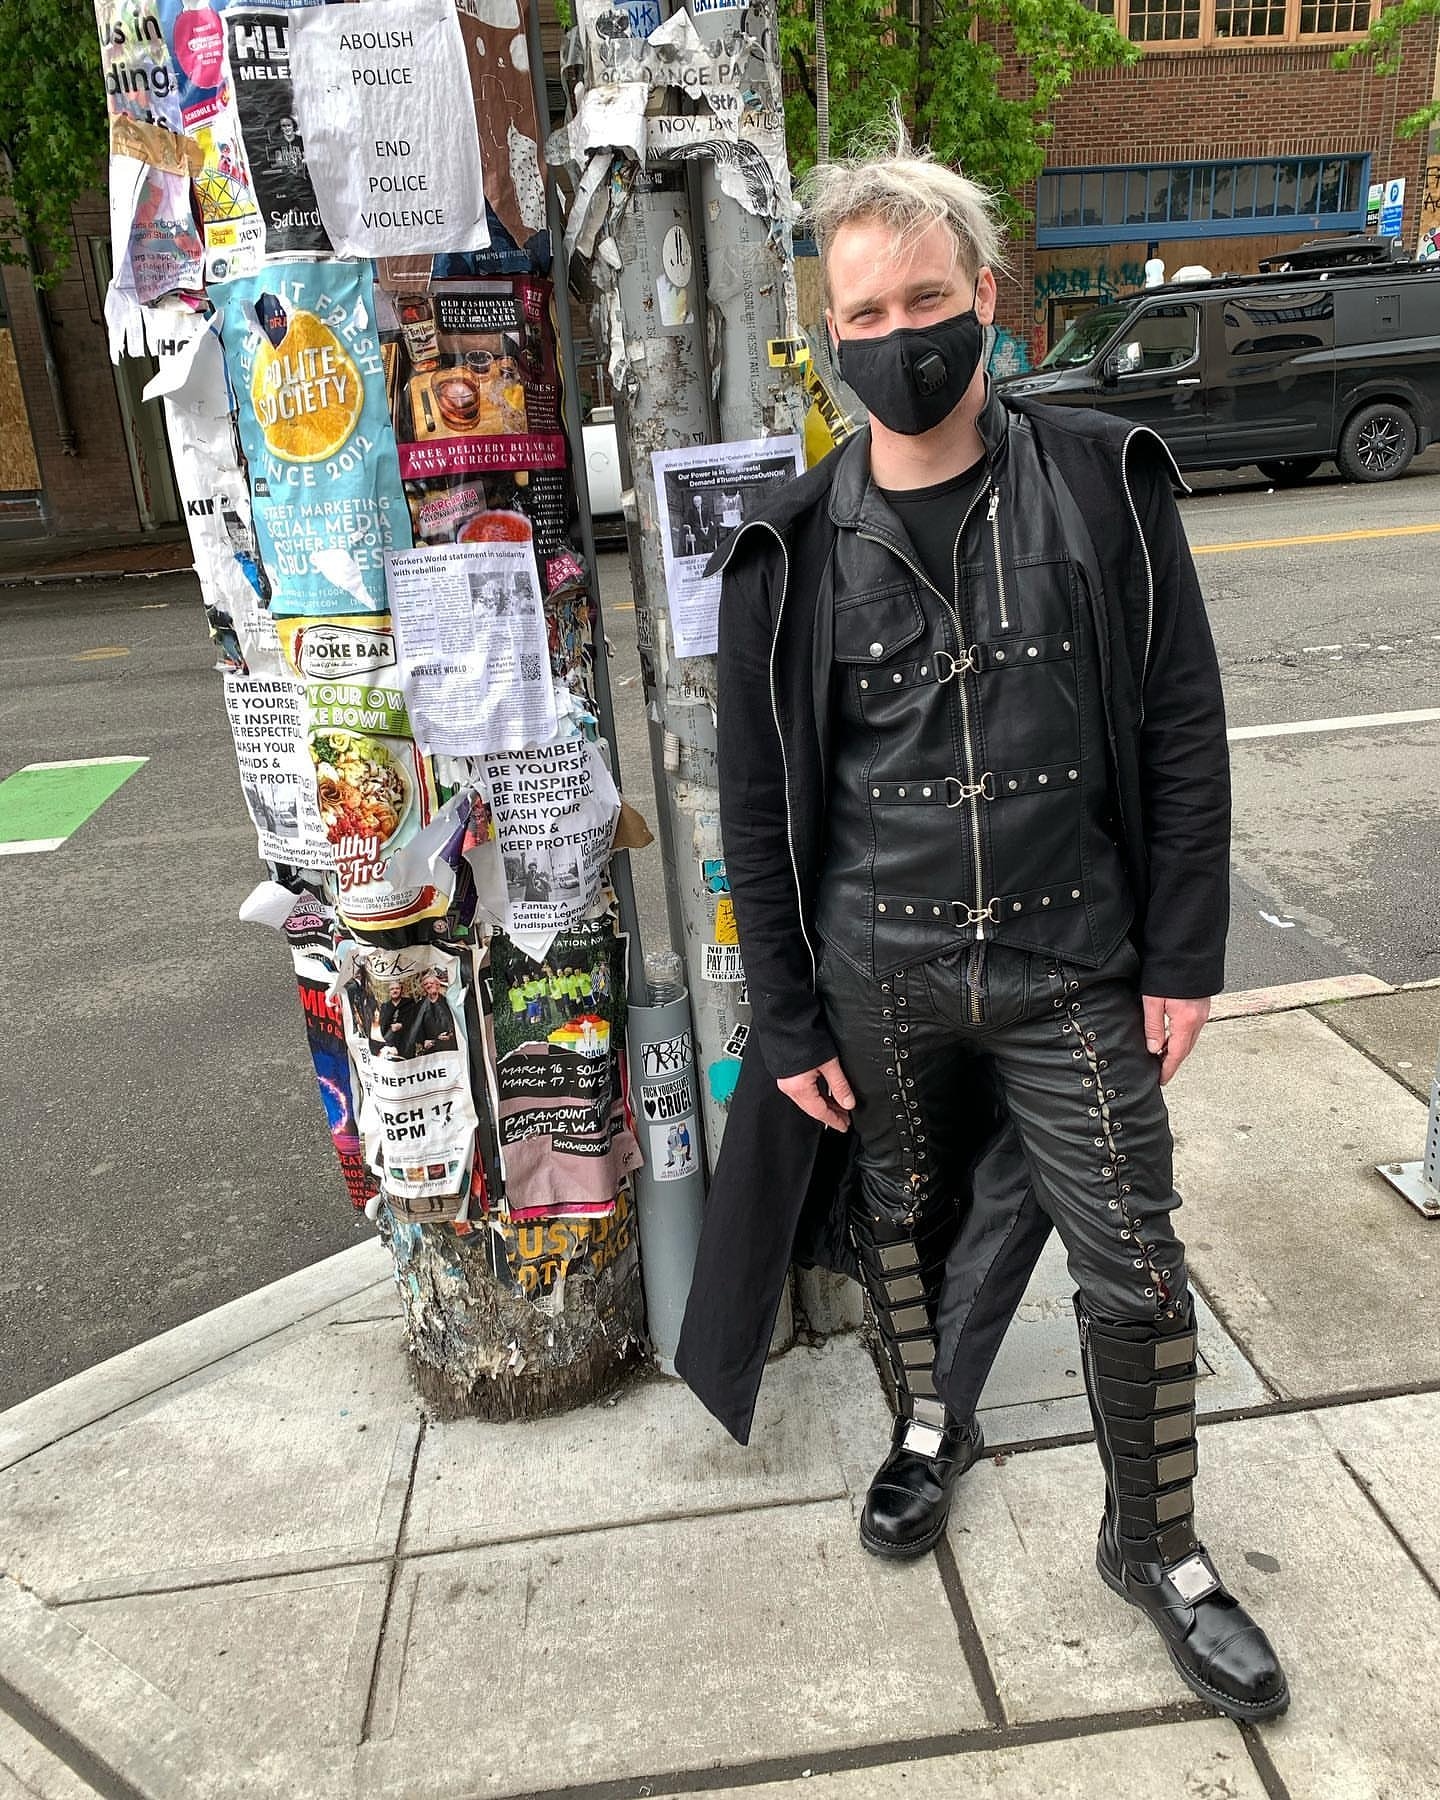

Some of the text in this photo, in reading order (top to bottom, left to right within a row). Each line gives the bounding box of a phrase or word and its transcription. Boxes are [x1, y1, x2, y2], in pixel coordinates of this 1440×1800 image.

[133, 10, 162, 41] in
[339, 31, 414, 51] ABOLISH
[352, 67, 412, 87] POLICE
[375, 139, 411, 157] END
[368, 173, 428, 193] POLICE
[361, 208, 445, 230] VIOLENCE
[440, 299, 515, 308] OLD FASHIONED
[441, 307, 515, 316] COCKTAIL KITS
[442, 314, 516, 323] FREE DLIVERY
[314, 293, 383, 376] FRESH
[265, 345, 338, 389] POLITE
[257, 374, 347, 427] SOCIETY
[326, 435, 373, 481] 2012
[409, 447, 444, 462] FREE
[447, 442, 504, 455] DELIVERY
[678, 473, 690, 481] Our
[691, 470, 711, 479] Power
[689, 479, 716, 487] Demand
[300, 496, 391, 517] MARKETING
[325, 512, 391, 533] MEDIA
[391, 550, 526, 568] Workers World statement in solidarity
[393, 564, 447, 577] with rebellion
[308, 642, 390, 658] POKE BAR
[410, 664, 467, 678] WORKERS WORLD
[226, 681, 294, 694] EMEMBER
[307, 685, 406, 713] YOUR OW
[332, 708, 389, 731] BOWL
[264, 743, 295, 753] YOUR
[272, 759, 281, 769] &
[487, 766, 511, 778] BE
[492, 770, 591, 795] BE INSPIRED
[493, 784, 594, 807] BE RESPECTFUL
[496, 802, 581, 822] WASH YOUR
[498, 823, 560, 839] HANDS &
[501, 839, 533, 853] KEEP
[375, 895, 389, 903] WA
[520, 902, 558, 911] Fantasy
[513, 911, 552, 920] Seattle's
[513, 920, 569, 930] Undisputed
[707, 954, 736, 970] PAY TO
[381, 1068, 447, 1088] NEPTUNE
[501, 1065, 546, 1076] MARCH
[550, 1064, 563, 1074] 16
[502, 1078, 547, 1088] MARCH
[550, 1077, 565, 1087] 17
[578, 1077, 595, 1089] ON
[642, 1075, 690, 1099] FUCK YOURSELVES
[431, 1101, 454, 1126] 17
[504, 1108, 591, 1131] PARAMOUNT
[386, 1123, 426, 1142] 8PM
[571, 1122, 597, 1133] WA
